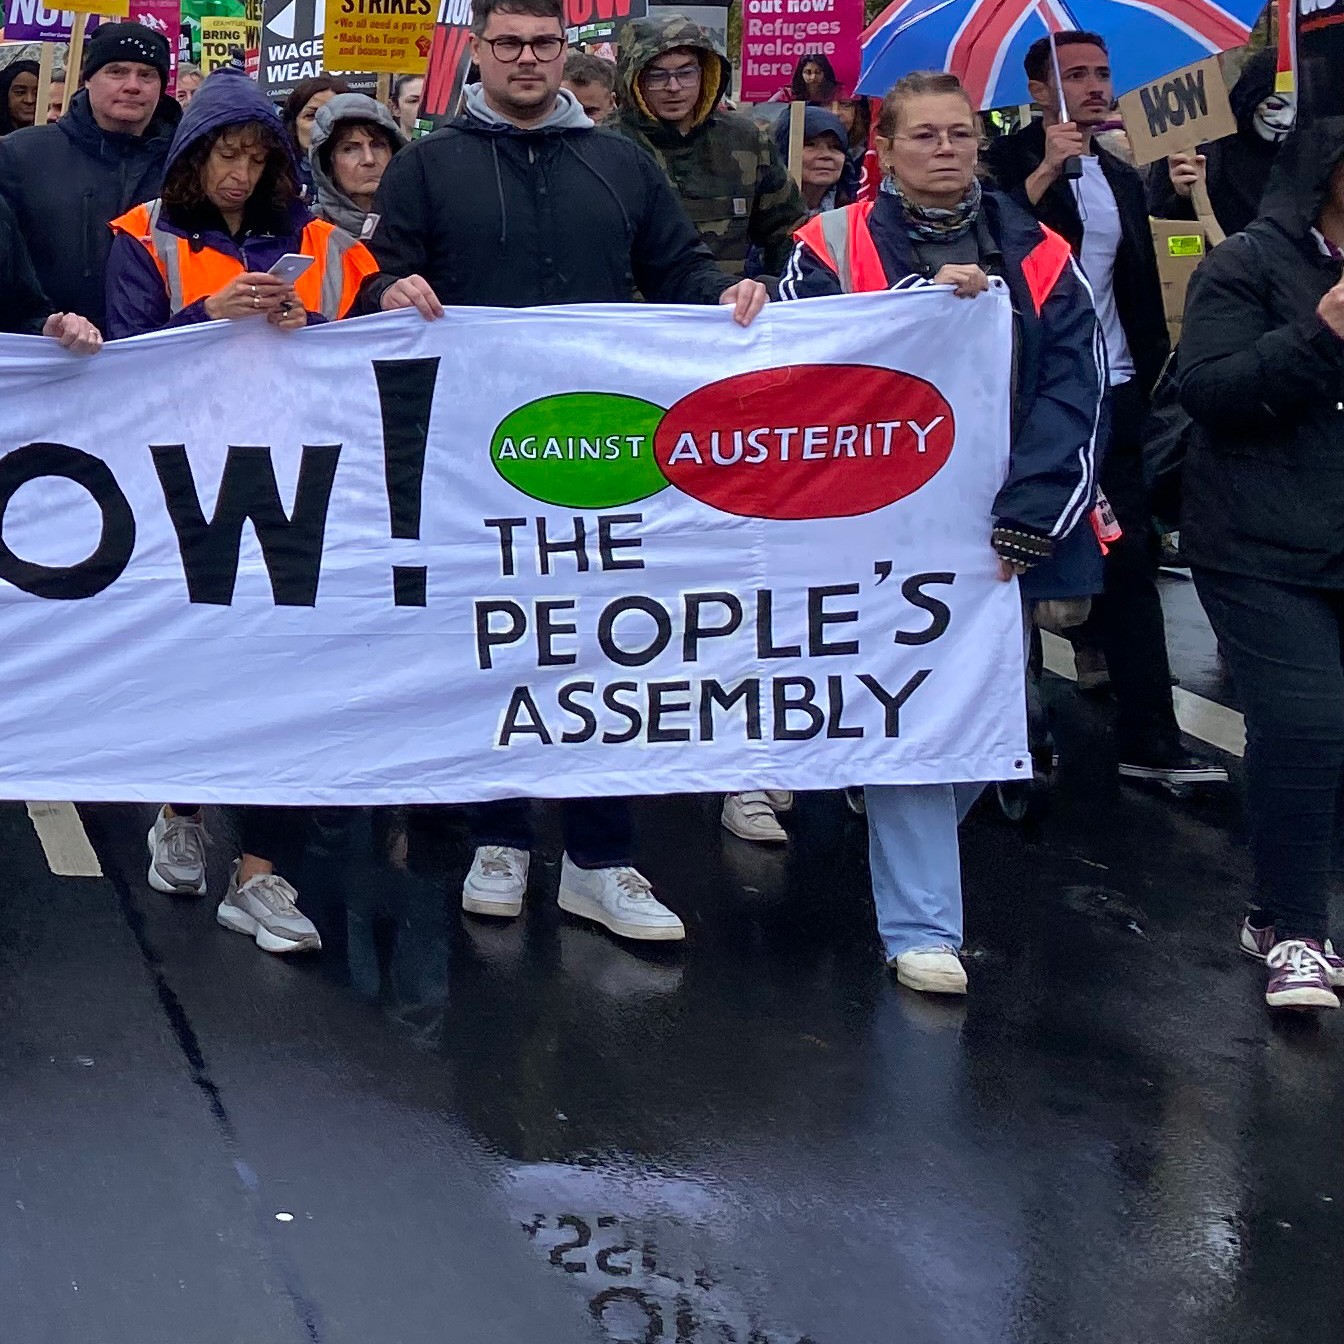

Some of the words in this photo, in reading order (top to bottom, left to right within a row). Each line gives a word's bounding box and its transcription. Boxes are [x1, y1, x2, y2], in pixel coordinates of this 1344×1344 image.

[748, 0, 783, 14] out
[340, 18, 353, 28] We
[356, 18, 367, 28] all
[370, 19, 390, 29] need
[402, 21, 416, 32] pay
[748, 19, 841, 39] Refugees
[203, 30, 240, 40] BRING
[340, 33, 361, 43] Make
[365, 33, 379, 43] the
[383, 33, 409, 44] Tories
[339, 46, 352, 55] and
[358, 46, 388, 57] bosses
[391, 47, 405, 58] pay
[747, 40, 836, 56] welcome
[746, 59, 793, 76] here
[1140, 69, 1207, 137] NOW
[498, 434, 648, 460] AGAINST
[667, 415, 945, 467] AUSTERITY
[483, 513, 645, 576] THE
[473, 560, 957, 671] PEOPLE'S
[498, 669, 933, 747] ASSEMBLY
